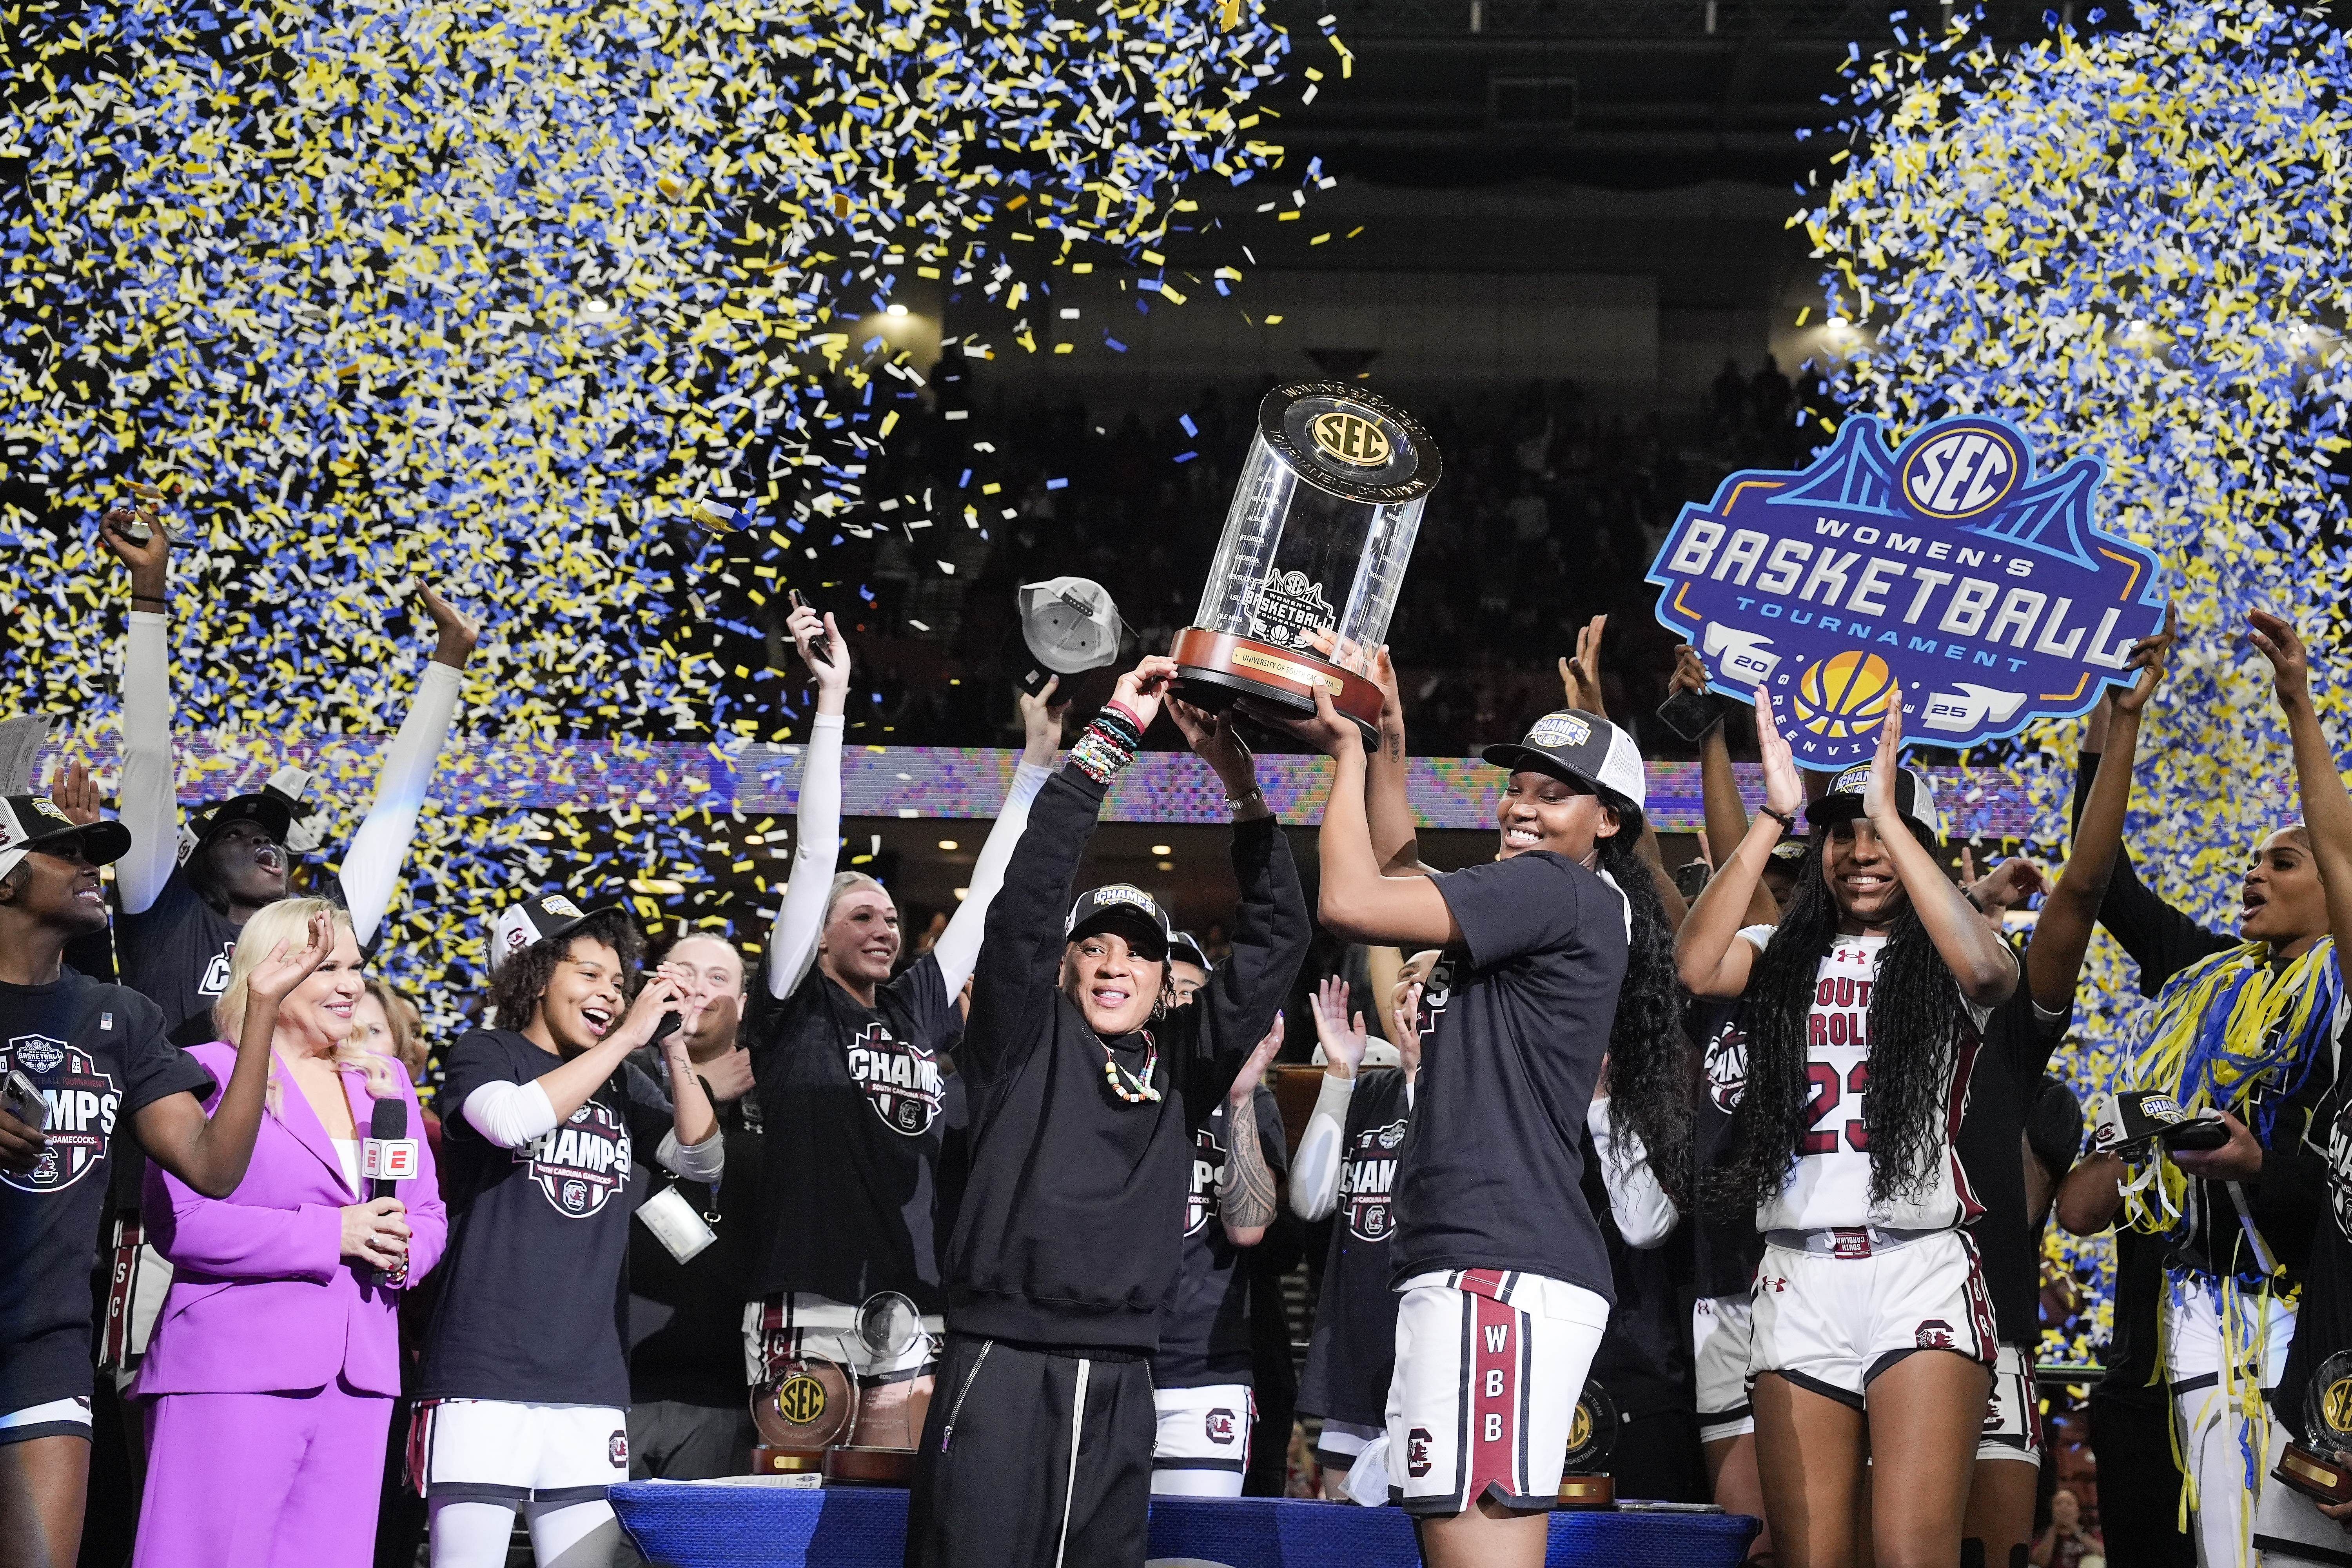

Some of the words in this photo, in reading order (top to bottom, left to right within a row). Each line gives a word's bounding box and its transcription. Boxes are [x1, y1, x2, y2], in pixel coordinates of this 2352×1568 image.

[1282, 383, 1345, 398] WOMN'S
[1321, 416, 1382, 459] SEC
[1911, 435, 2008, 511] SEC
[1241, 534, 1265, 544] FLORIDA
[1815, 516, 2034, 578] WOMEN'S
[1286, 575, 1305, 595] SEC
[1369, 571, 1385, 584] SOUTH
[1269, 593, 1312, 611] WOMEN'S
[1668, 518, 2136, 670] BASKETBALL
[1245, 589, 1331, 631] BASKETBALL
[1257, 611, 1313, 632] TOURNAMENT
[1736, 597, 2028, 672] TOURNAMENT
[1242, 654, 1276, 669] UNIVERSITY
[1286, 667, 1305, 678] SOUTH
[1306, 673, 1334, 689] CANA
[1733, 655, 1768, 673] 20
[1772, 673, 1915, 756] GREENVILE
[1930, 704, 1968, 718] 25
[1532, 719, 1586, 741] CHAMPS
[1838, 770, 1870, 788] CHAM
[1096, 889, 1154, 913] CHAMPS
[1816, 977, 1873, 1007] OUT
[33, 1040, 42, 1050] SEC
[73, 1062, 80, 1070] 25
[848, 1048, 945, 1098] CHAMP
[872, 1083, 891, 1093] SOUTH
[42, 1089, 118, 1134] MPS
[1795, 1060, 1870, 1156] 23
[52, 1135, 96, 1144] GAMECOCKS
[391, 1151, 407, 1168] E
[553, 1168, 583, 1179] CAROLINA
[583, 1172, 613, 1185] GAMOCKS
[1339, 1160, 1398, 1193] CHAM
[1836, 1236, 1865, 1244] CAROLINA
[783, 1379, 821, 1419] SEC
[2327, 1382, 2352, 1429] SE
[1564, 1445, 1599, 1465] ASKETBALL
